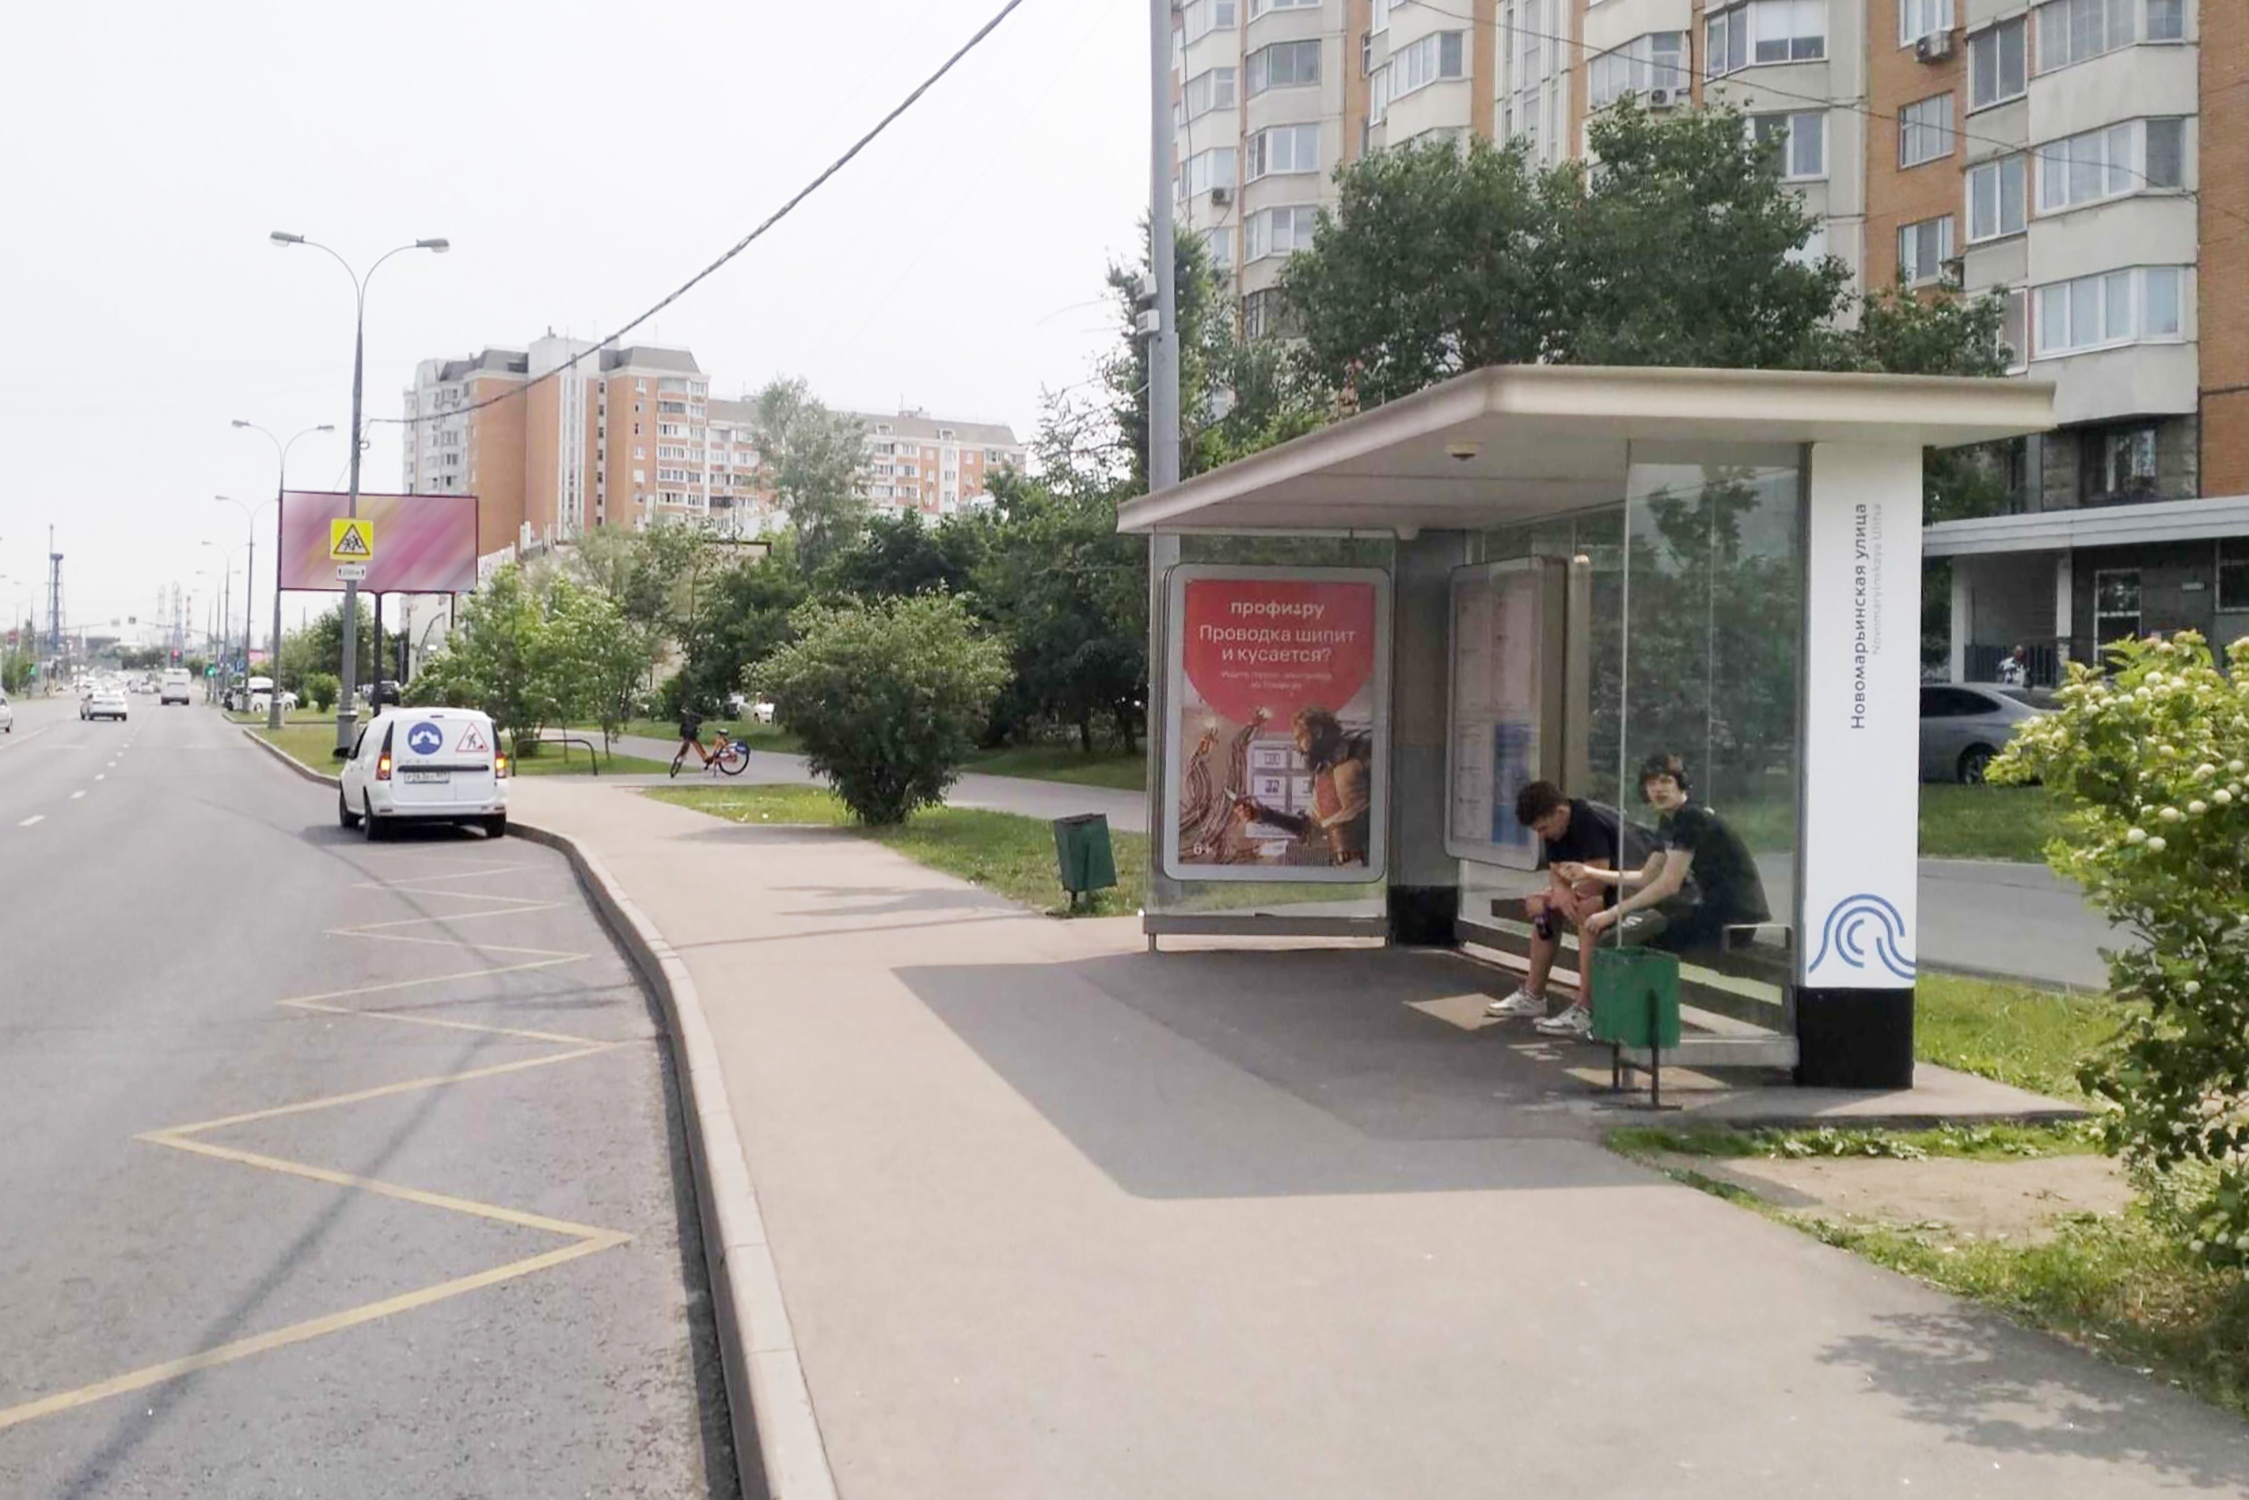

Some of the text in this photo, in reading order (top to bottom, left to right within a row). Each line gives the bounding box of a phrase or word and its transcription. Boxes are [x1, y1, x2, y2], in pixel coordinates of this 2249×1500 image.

[1851, 503, 1869, 729] Новомарьинская улица
[1199, 625, 1356, 643] Проводка шипит
[1222, 647, 1332, 664] и кусается?
